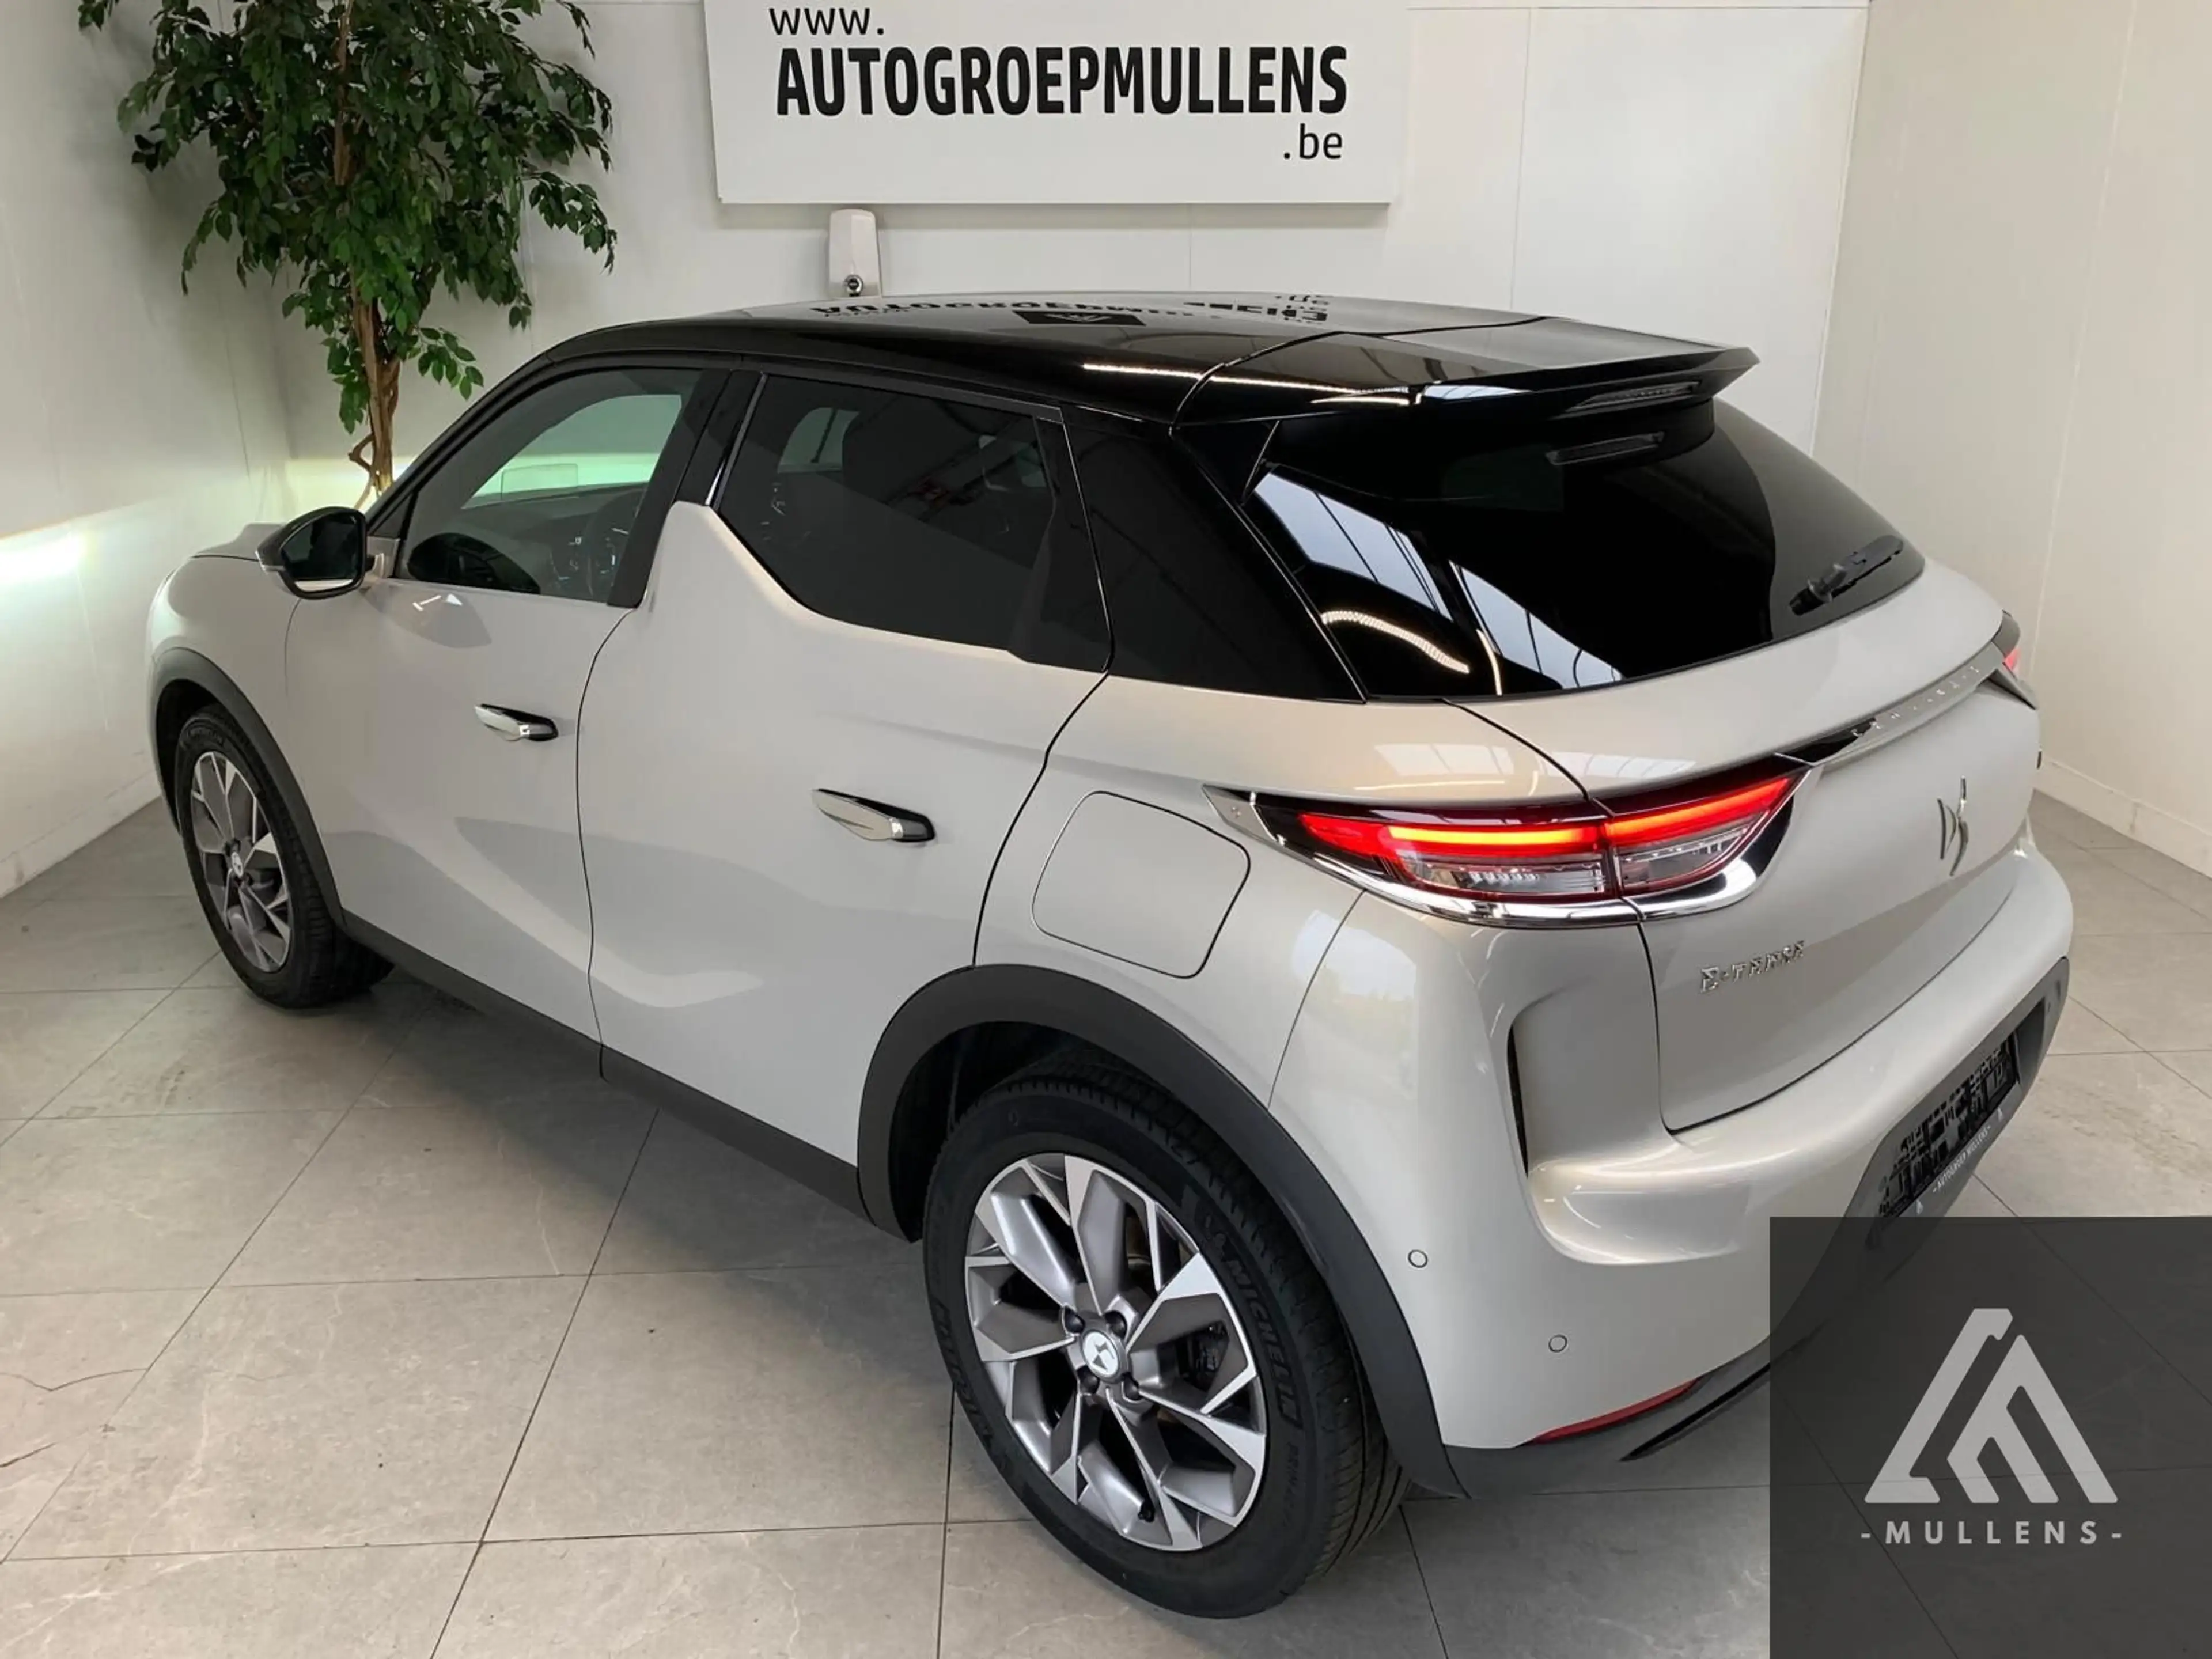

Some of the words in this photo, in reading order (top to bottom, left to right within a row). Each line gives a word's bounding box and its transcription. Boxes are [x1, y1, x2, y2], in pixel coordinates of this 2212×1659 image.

[769, 7, 884, 36] www.
[777, 46, 1347, 116] AUTOGROEPMULLENS
[1284, 123, 1343, 160] .be
[1225, 1259, 1300, 1425] MICHELIN
